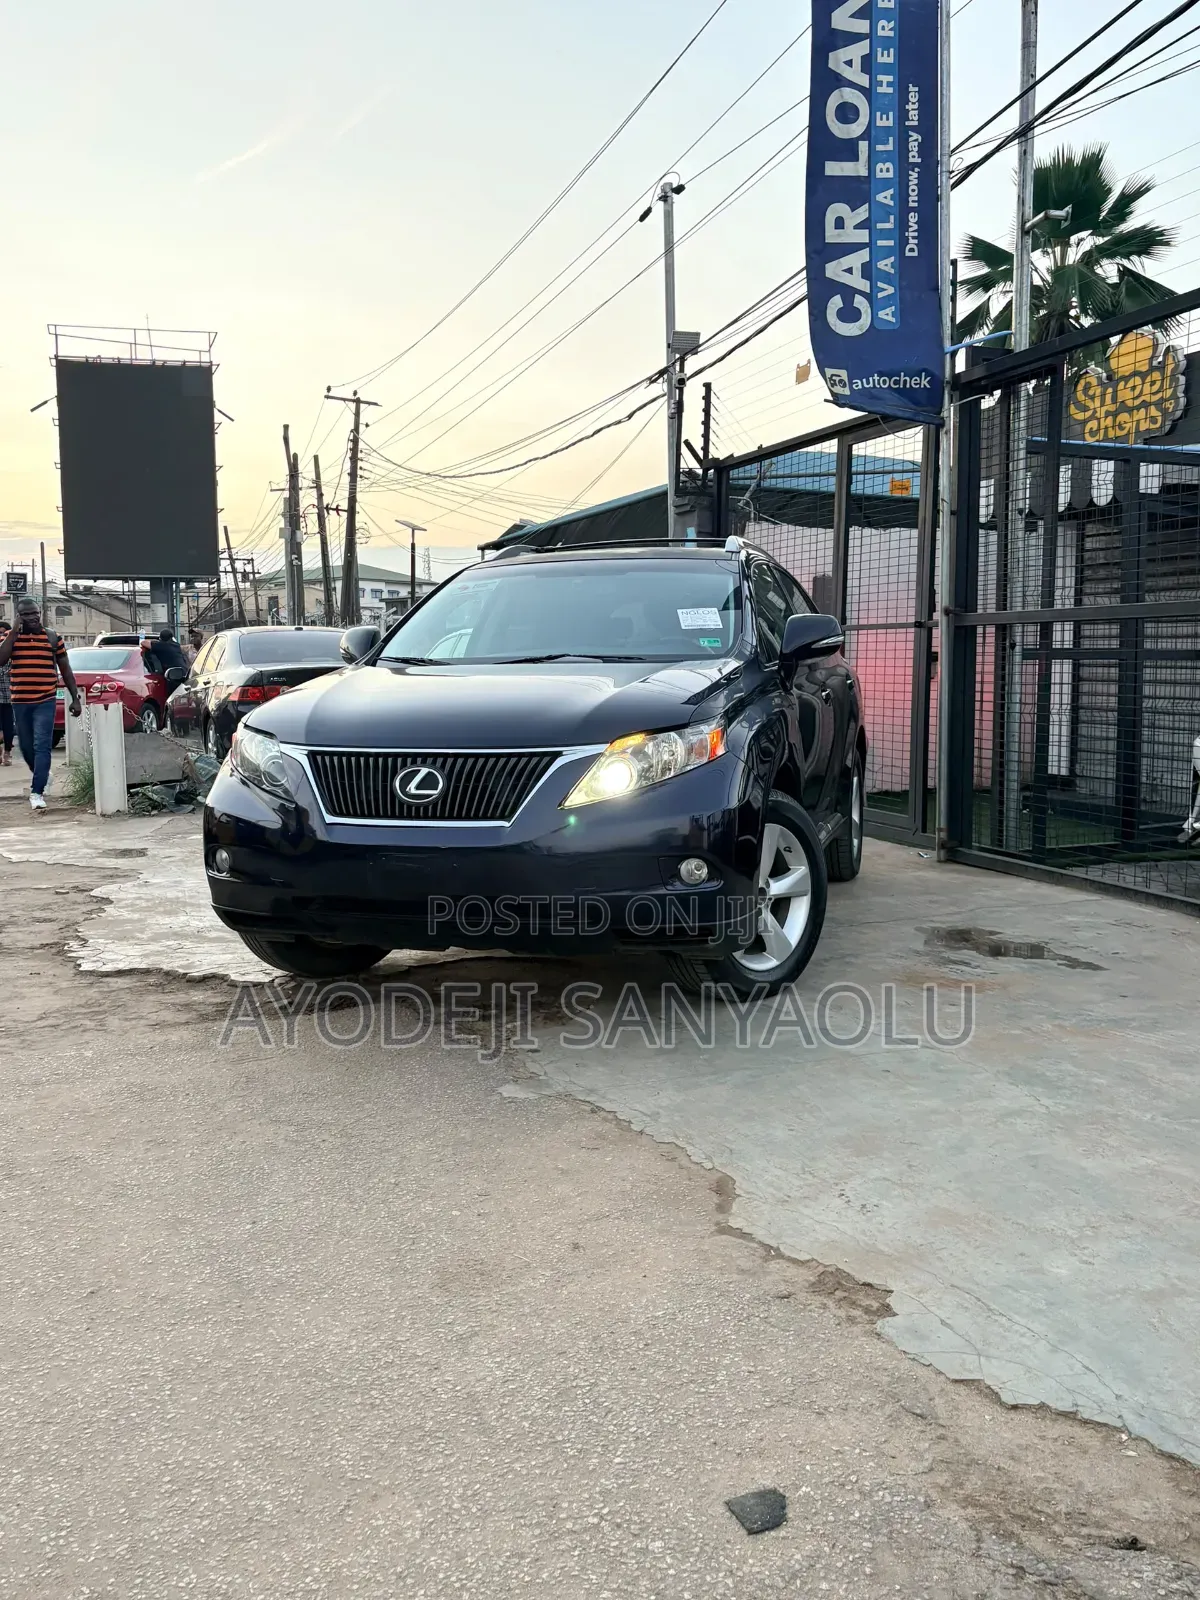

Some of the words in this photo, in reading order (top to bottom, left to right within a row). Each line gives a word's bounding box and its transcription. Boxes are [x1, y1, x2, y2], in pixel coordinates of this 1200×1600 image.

[905, 83, 919, 126] later
[908, 131, 922, 163] pay
[908, 168, 921, 207] now,
[875, 112, 896, 323] AVAILABLE
[905, 212, 919, 256] Drive
[825, 202, 872, 337] CAR
[852, 372, 932, 390] autochek
